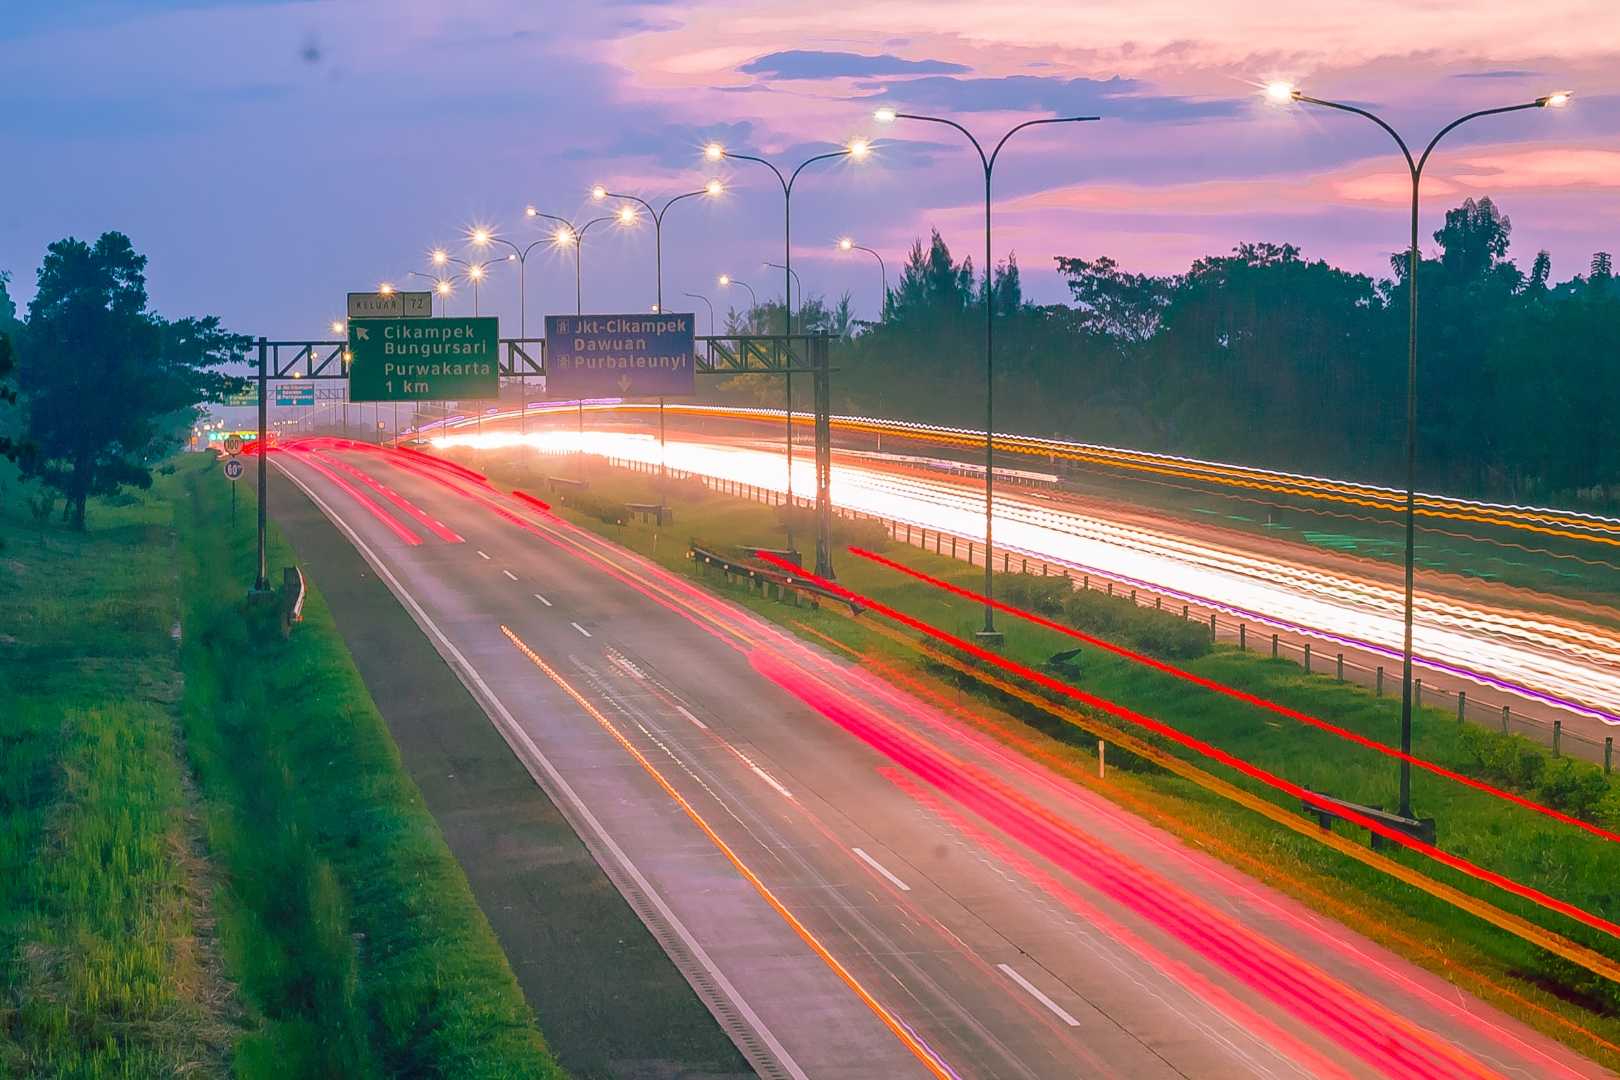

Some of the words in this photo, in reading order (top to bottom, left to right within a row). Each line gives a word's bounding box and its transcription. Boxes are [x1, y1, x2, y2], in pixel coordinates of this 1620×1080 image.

[410, 297, 423, 309] 72
[384, 324, 475, 342] Cikampek
[575, 319, 686, 335] Jkt-Cikampek
[385, 340, 487, 357] Bungursari
[574, 338, 646, 351] Dawuan
[385, 362, 490, 376] Purwakarta
[575, 354, 686, 370] Purbaleunyi
[386, 380, 392, 392] 1
[404, 380, 429, 393] km
[228, 440, 238, 449] 100
